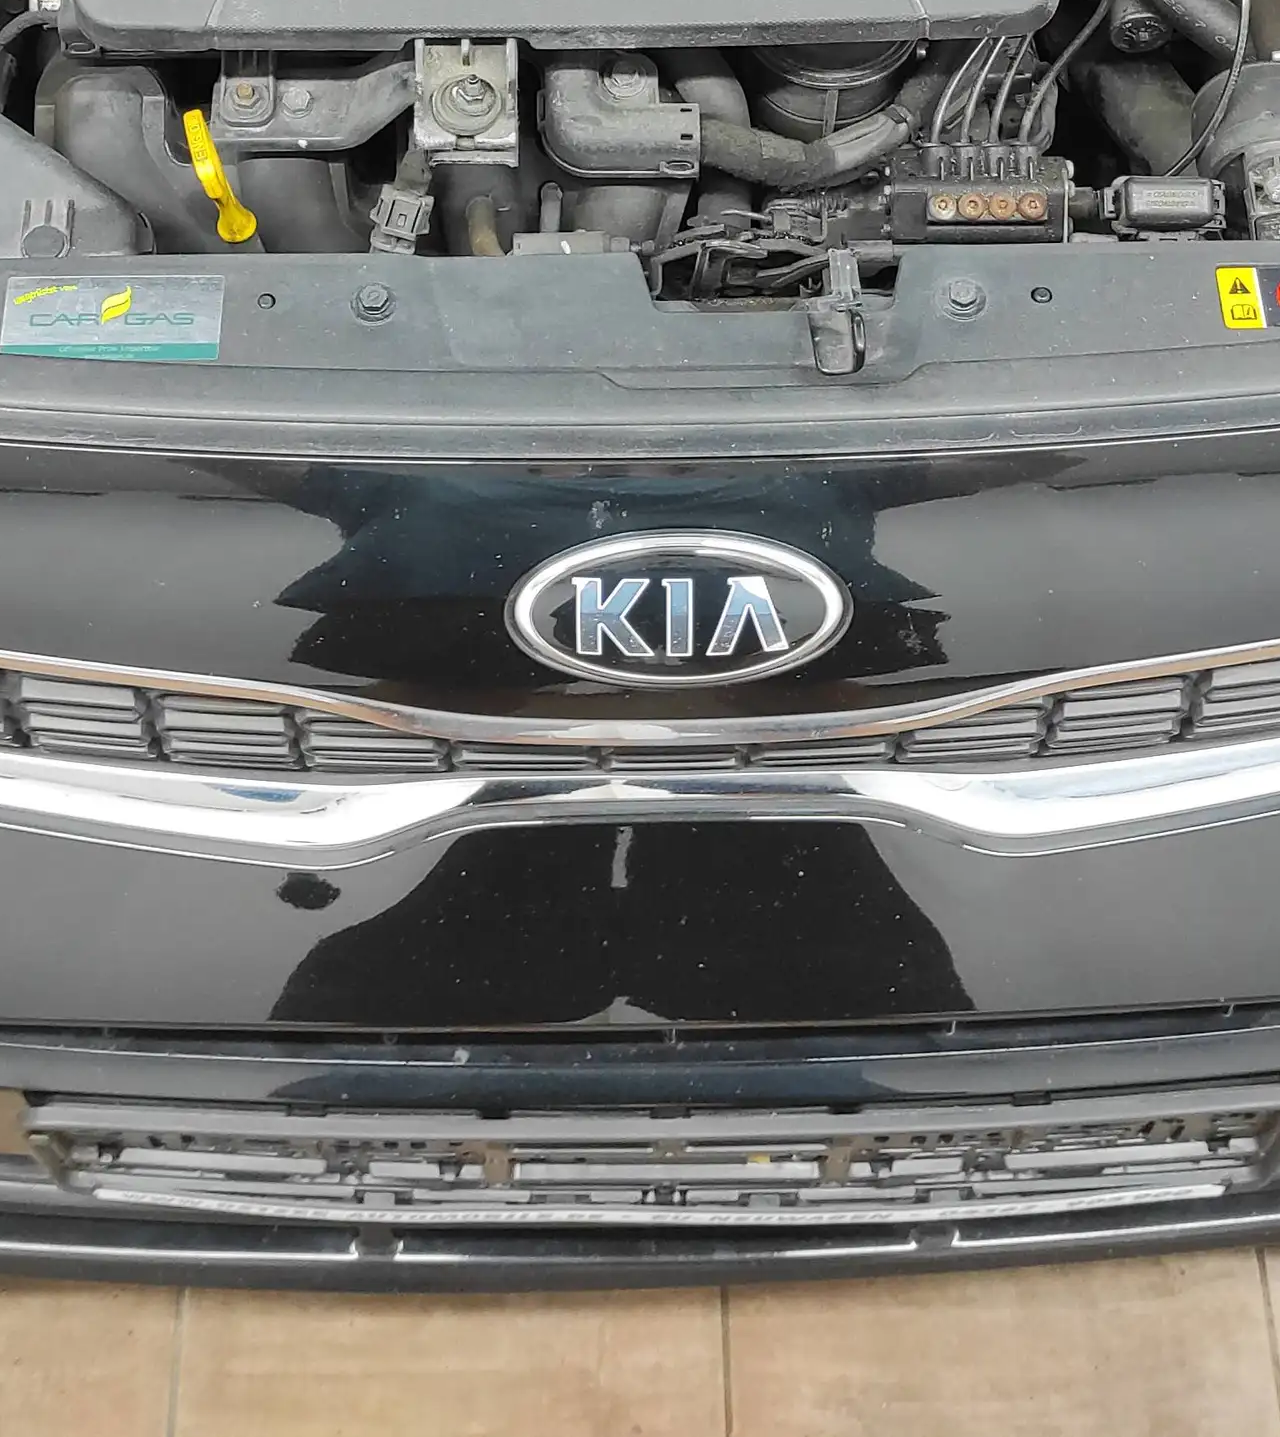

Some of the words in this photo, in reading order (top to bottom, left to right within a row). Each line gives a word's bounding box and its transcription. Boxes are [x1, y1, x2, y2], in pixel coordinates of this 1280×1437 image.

[29, 313, 100, 327] CAR
[124, 312, 195, 327] GAS
[571, 576, 789, 657] KIA
